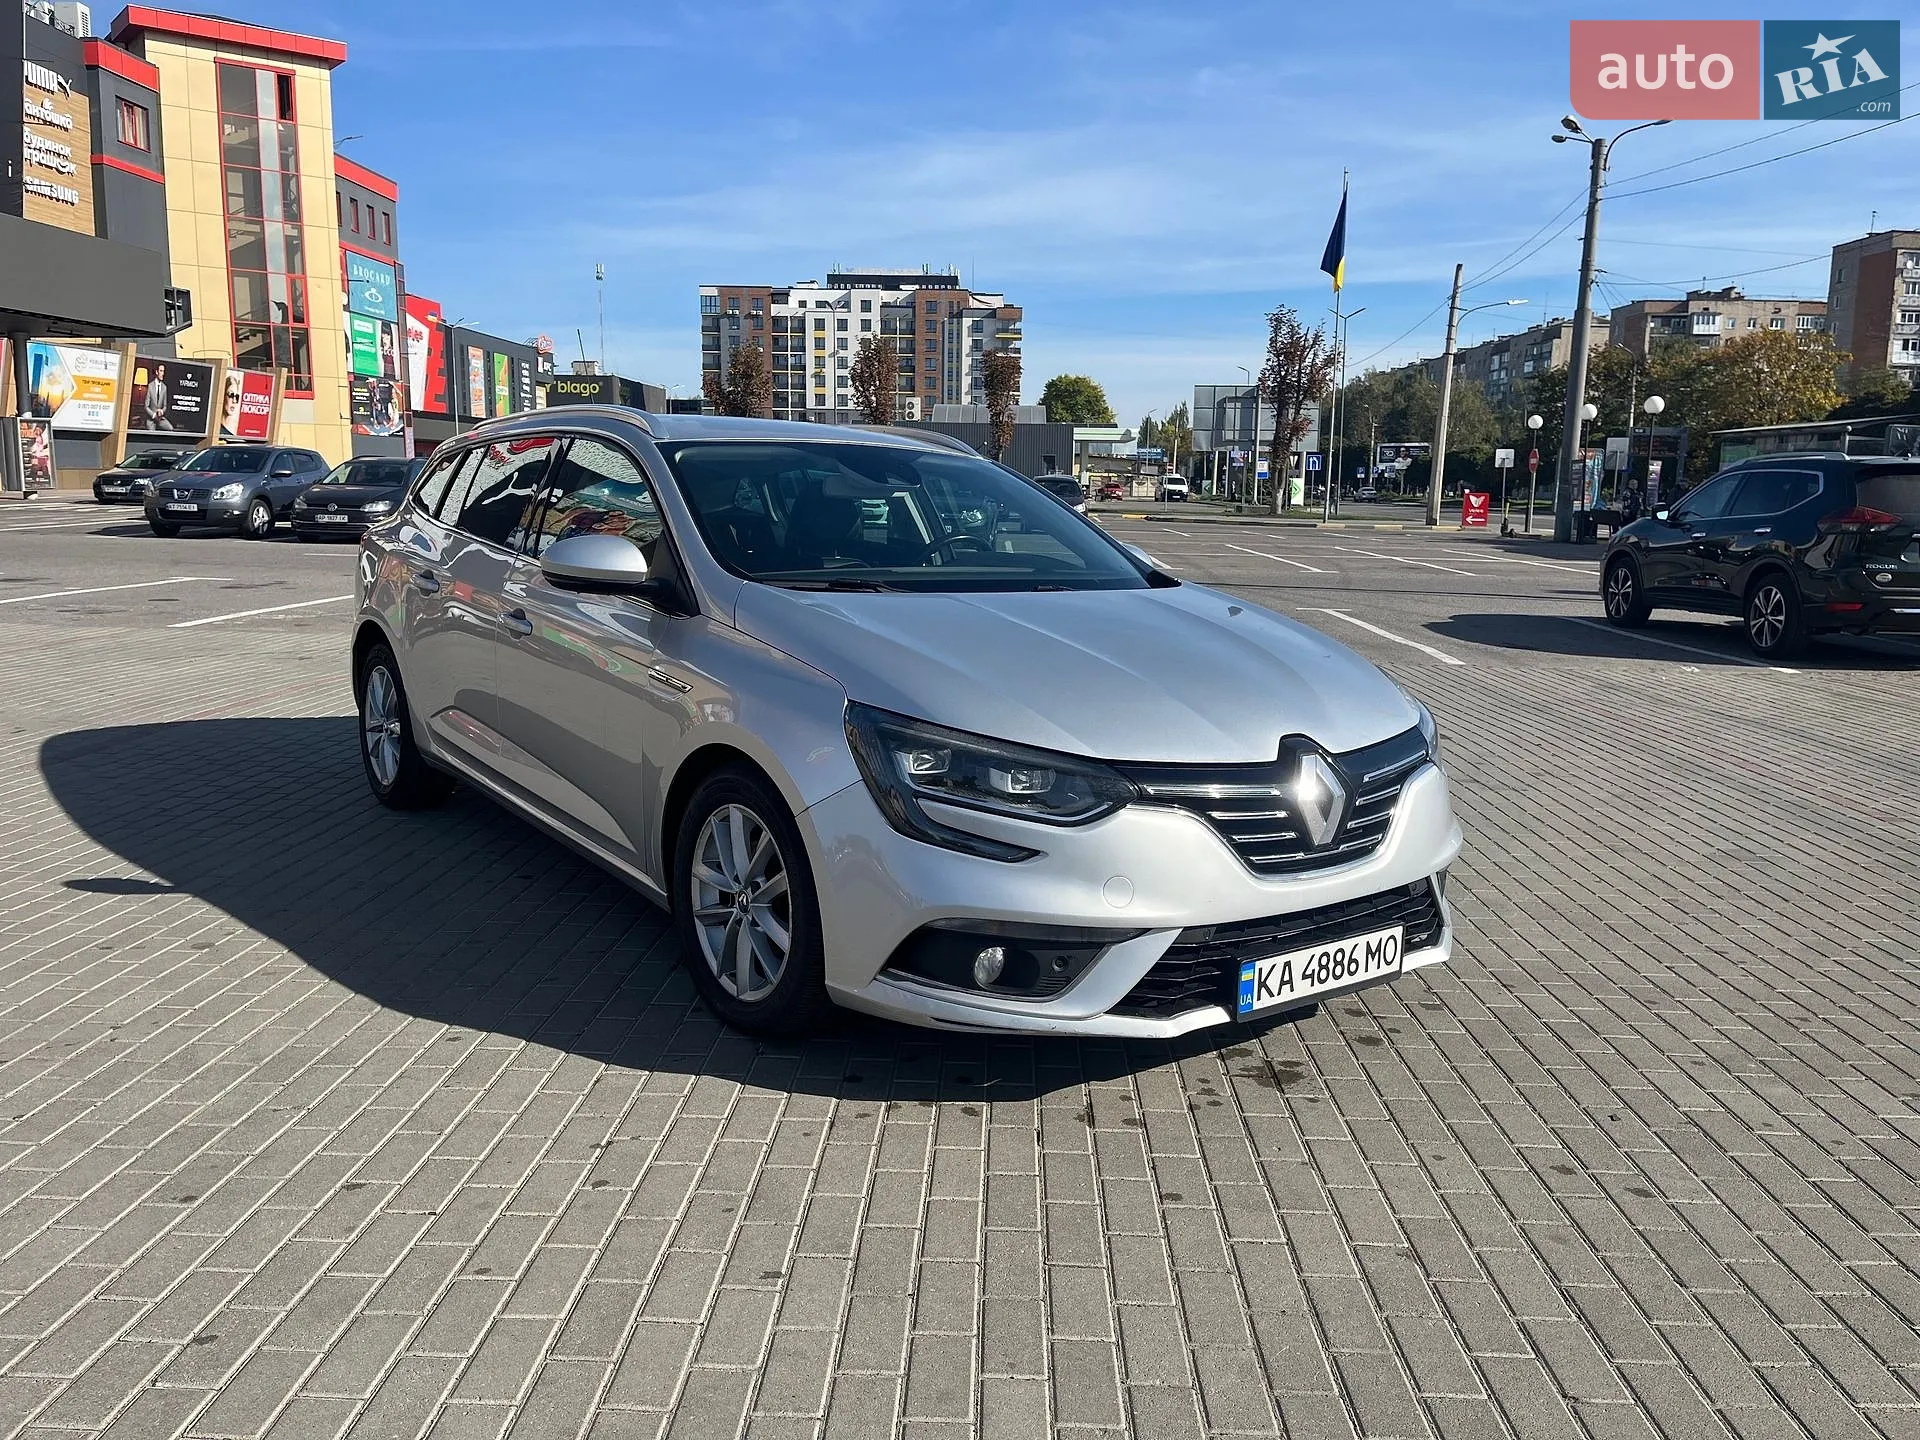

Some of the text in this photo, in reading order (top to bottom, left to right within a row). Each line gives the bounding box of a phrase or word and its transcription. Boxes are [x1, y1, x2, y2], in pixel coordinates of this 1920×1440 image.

[24, 176, 79, 203] SAMSUNG
[353, 264, 391, 286] BROCARD
[243, 392, 270, 404] ОПТИКА
[1256, 934, 1398, 1001] KA 4886 MO
[1240, 994, 1253, 1006] UA
